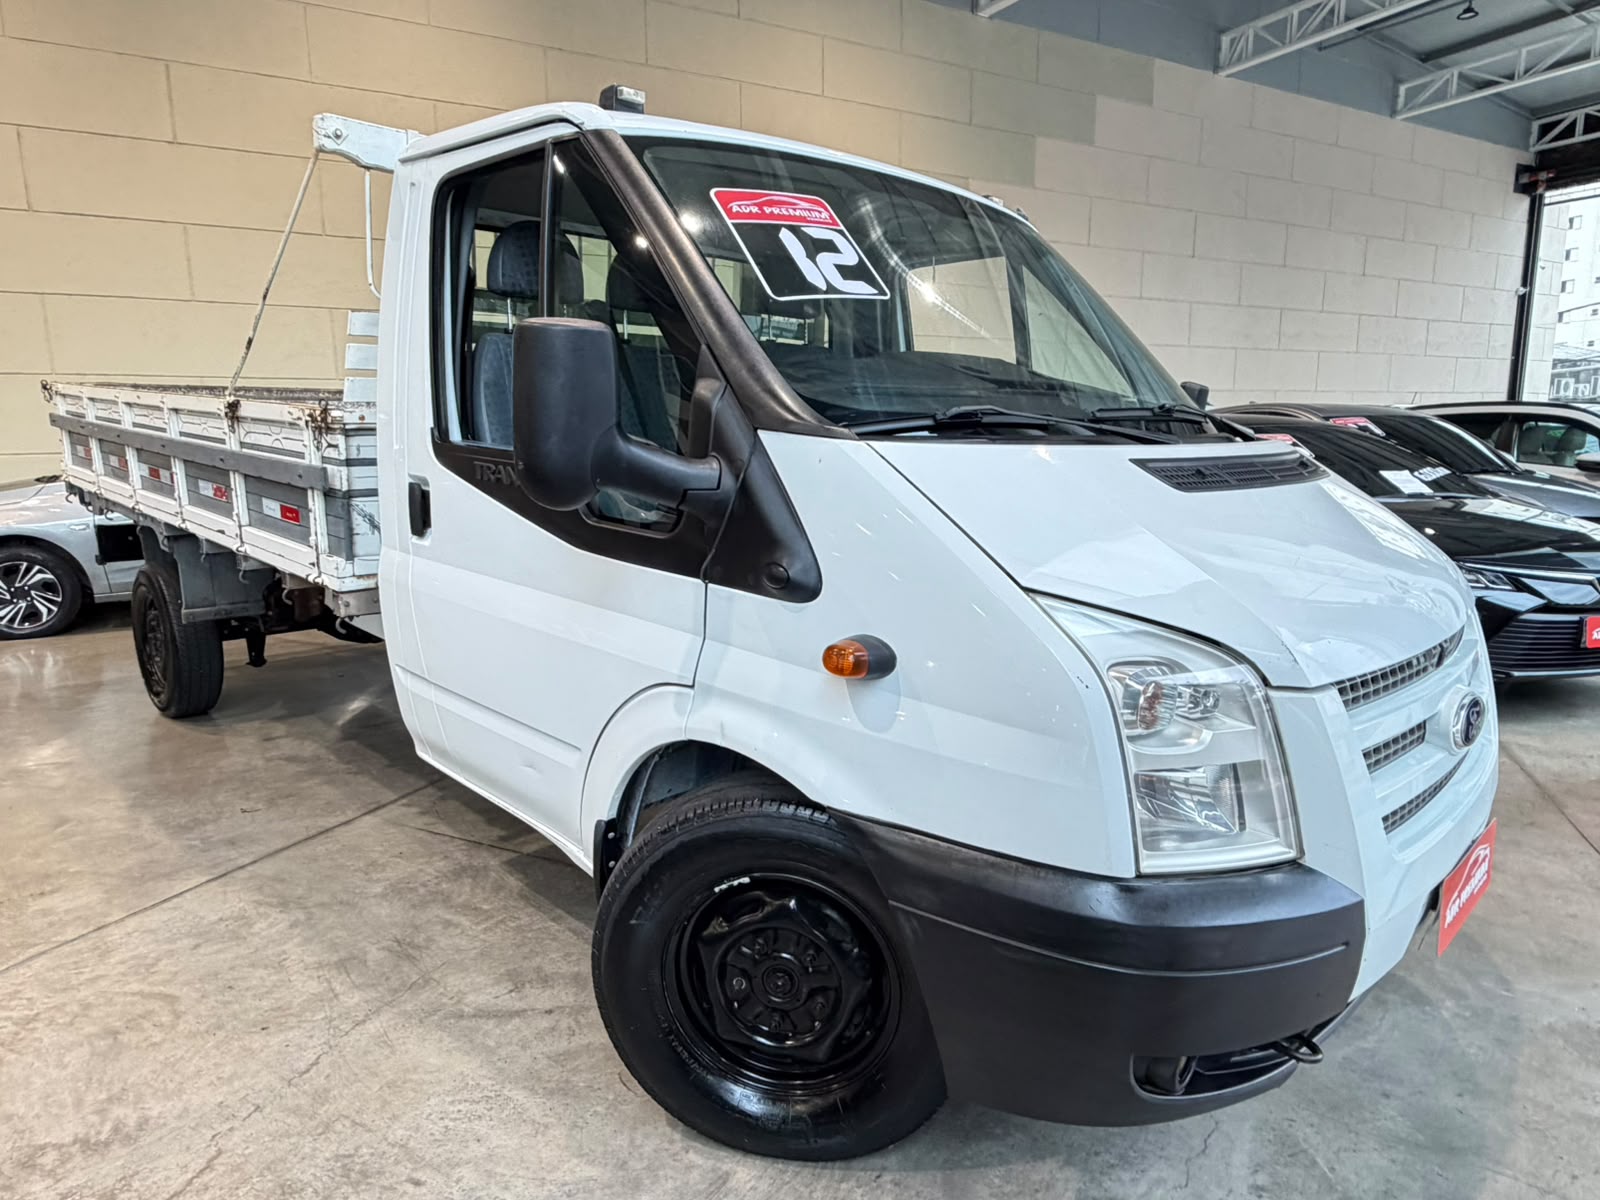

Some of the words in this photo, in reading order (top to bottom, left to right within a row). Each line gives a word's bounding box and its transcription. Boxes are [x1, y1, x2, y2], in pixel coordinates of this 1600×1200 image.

[732, 205, 761, 214] ADR
[763, 206, 831, 220] PREMIUM
[779, 227, 879, 294] 12
